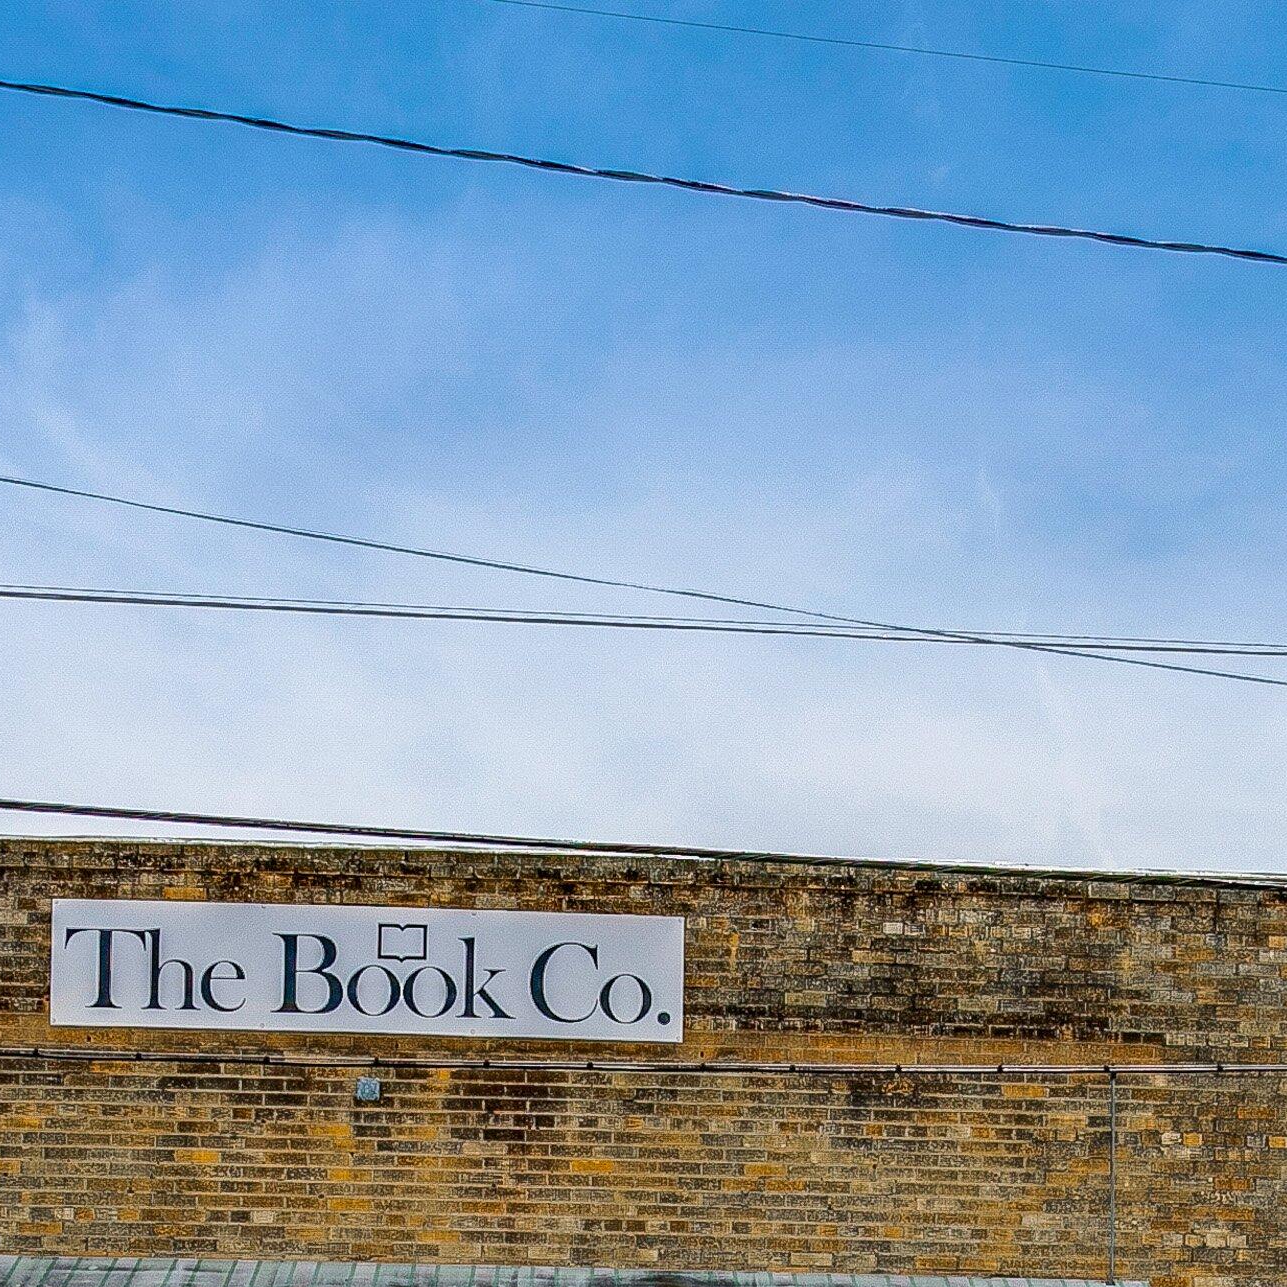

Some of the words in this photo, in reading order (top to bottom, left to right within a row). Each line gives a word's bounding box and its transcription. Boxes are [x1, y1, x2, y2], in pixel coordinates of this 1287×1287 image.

[65, 928, 246, 1012] The
[272, 932, 515, 1020] Book
[530, 941, 672, 1025] Co.
